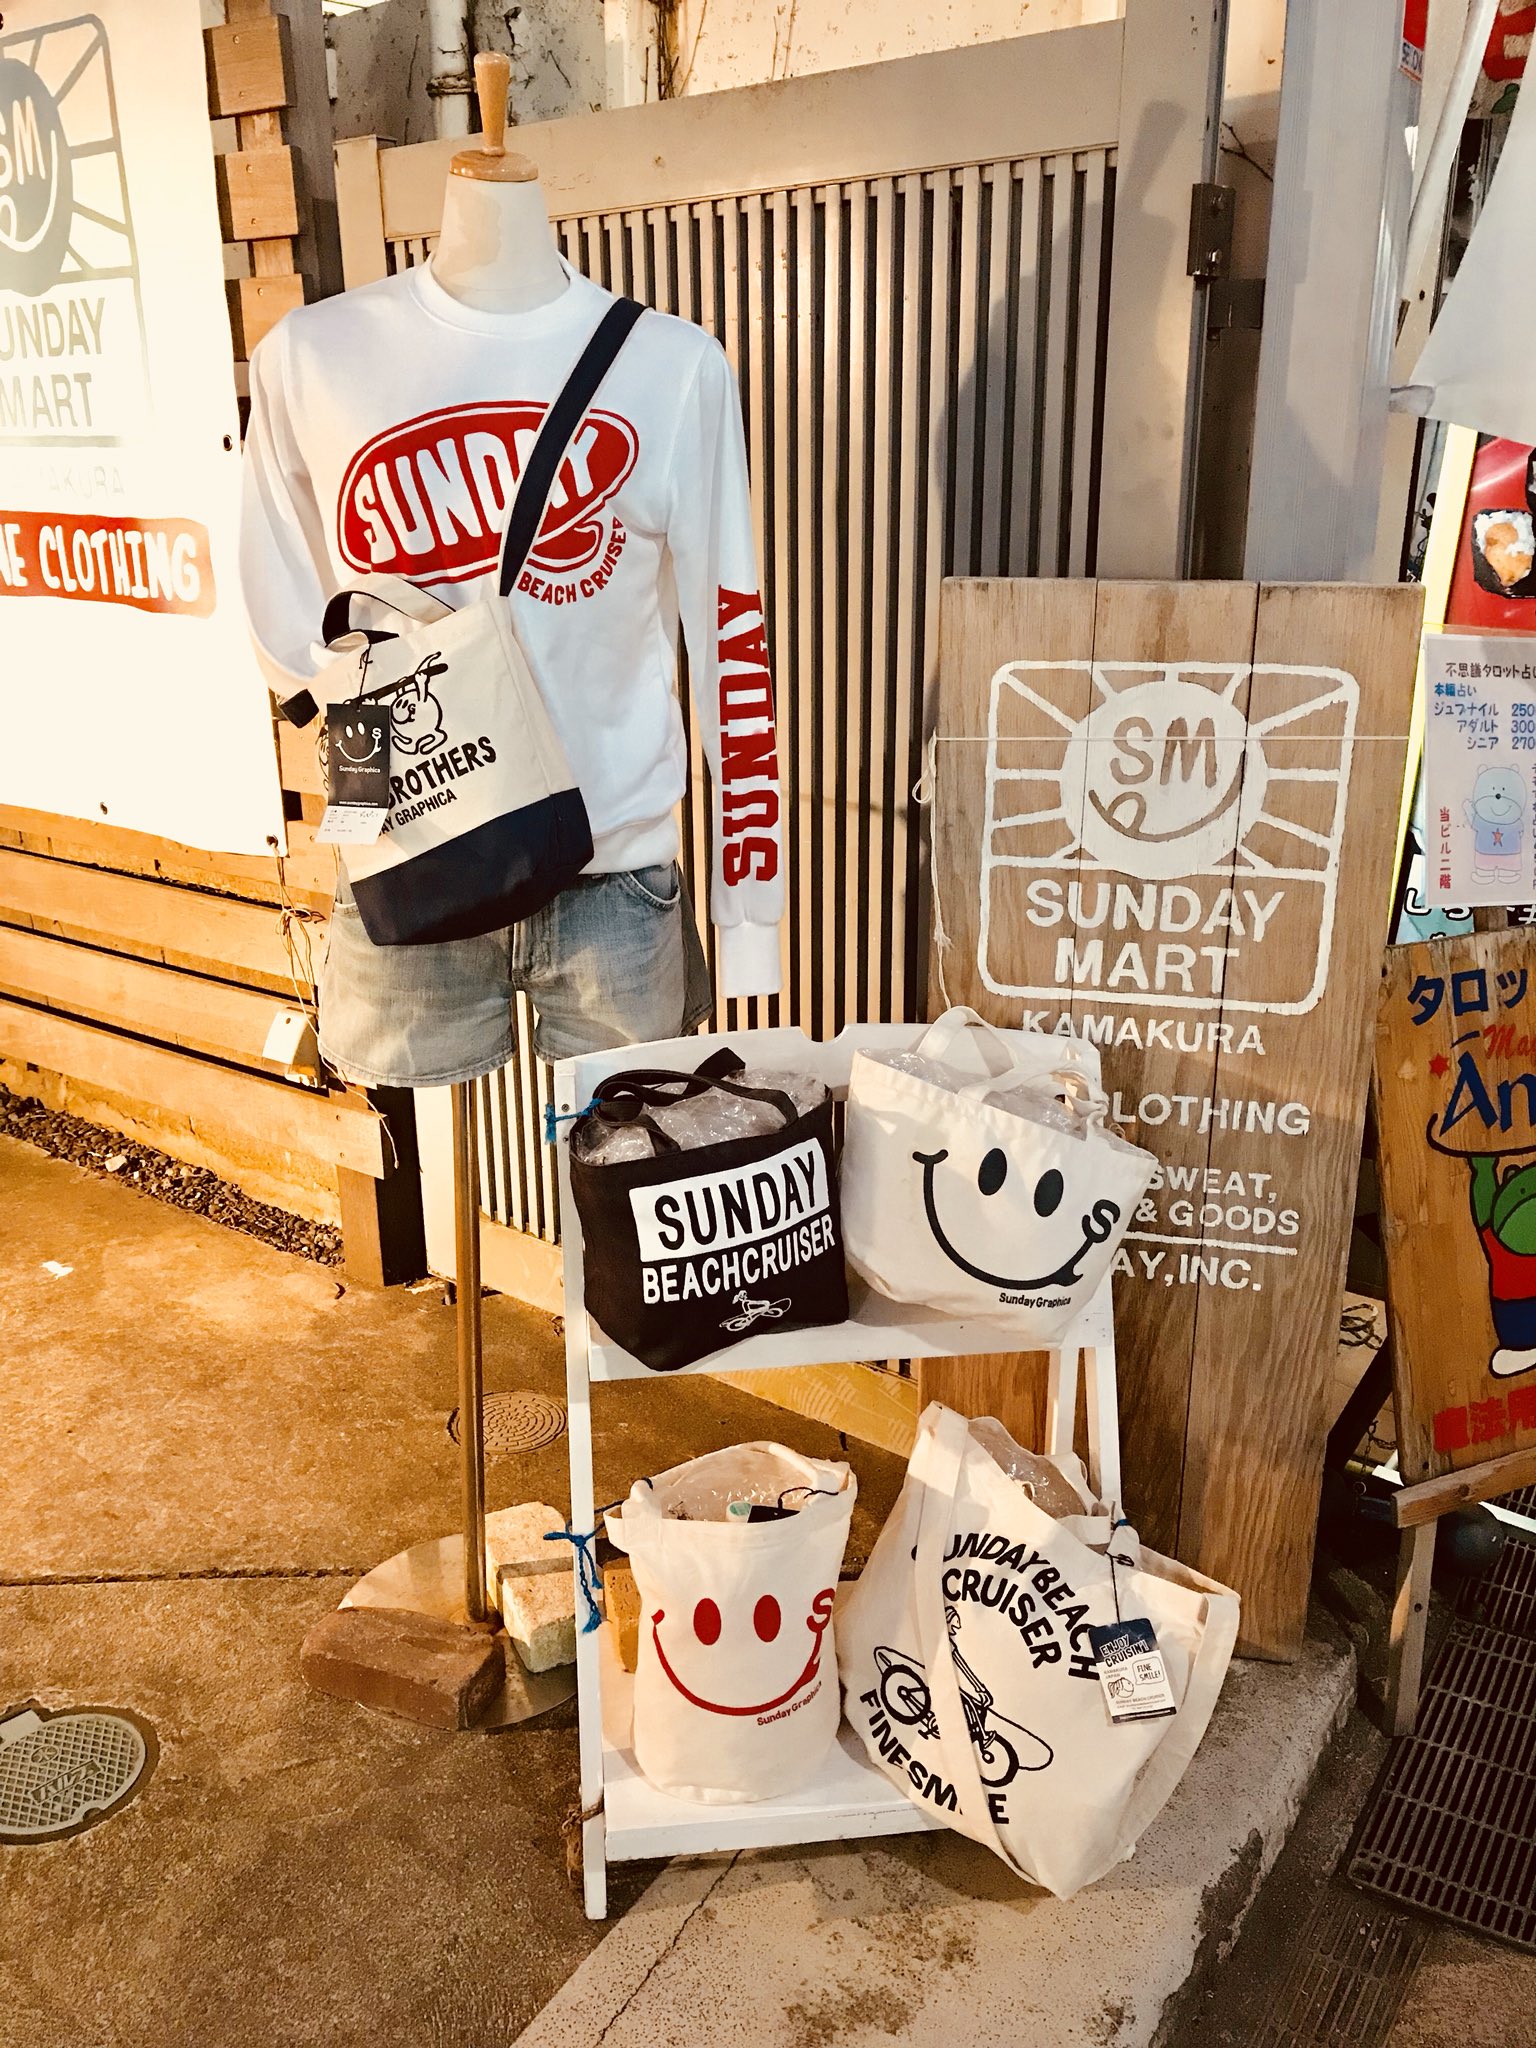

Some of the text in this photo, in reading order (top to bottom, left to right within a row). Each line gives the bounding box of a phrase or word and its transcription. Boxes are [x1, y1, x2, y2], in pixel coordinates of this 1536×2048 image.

[0, 372, 92, 428] MART
[38, 525, 200, 602] CLOTHING
[517, 571, 577, 605] BEACH
[718, 584, 778, 887] SUNDAY
[1457, 719, 1498, 733] アダルト
[1467, 737, 1499, 750] シニア
[339, 765, 381, 774] Sunday Graphica
[388, 736, 497, 810] ROTHERS
[1110, 716, 1217, 788] SM
[395, 788, 457, 826] GRAPHICA
[1026, 881, 1285, 942] SUNDAY
[1054, 937, 1240, 994] MART
[1022, 1009, 1266, 1056] KAMAKURA
[654, 1150, 815, 1250] SUNDAY
[1147, 1165, 1277, 1204] SWEAT,
[1135, 1198, 1299, 1235] & GOODS
[642, 1214, 835, 1304] BEACHCRUISER
[999, 1292, 1071, 1308] Sunday Graphica
[942, 1568, 1062, 1669] CRUISER
[1099, 1634, 1130, 1656] ENJOY
[1137, 1663, 1152, 1672] FINE
[757, 1708, 791, 1726] Sunday
